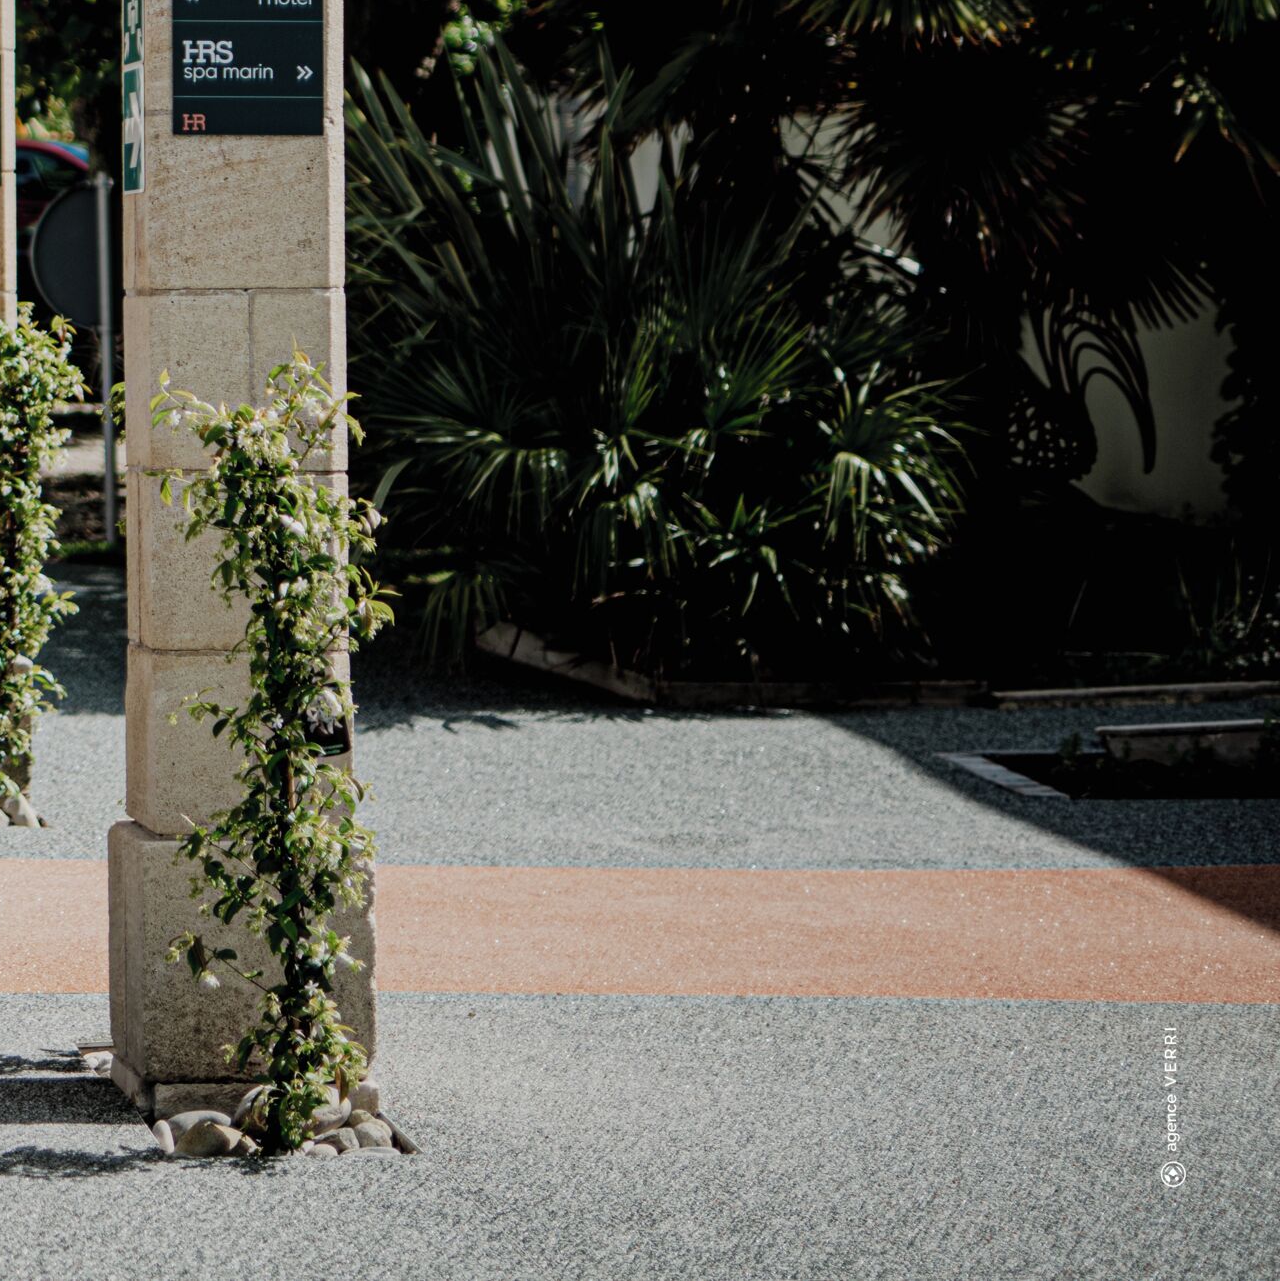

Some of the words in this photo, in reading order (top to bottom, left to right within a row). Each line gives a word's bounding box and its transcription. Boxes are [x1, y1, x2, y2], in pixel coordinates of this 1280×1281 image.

[182, 40, 234, 64] HRS
[183, 65, 217, 82] spa
[223, 63, 274, 80] marin
[182, 114, 206, 131] HR
